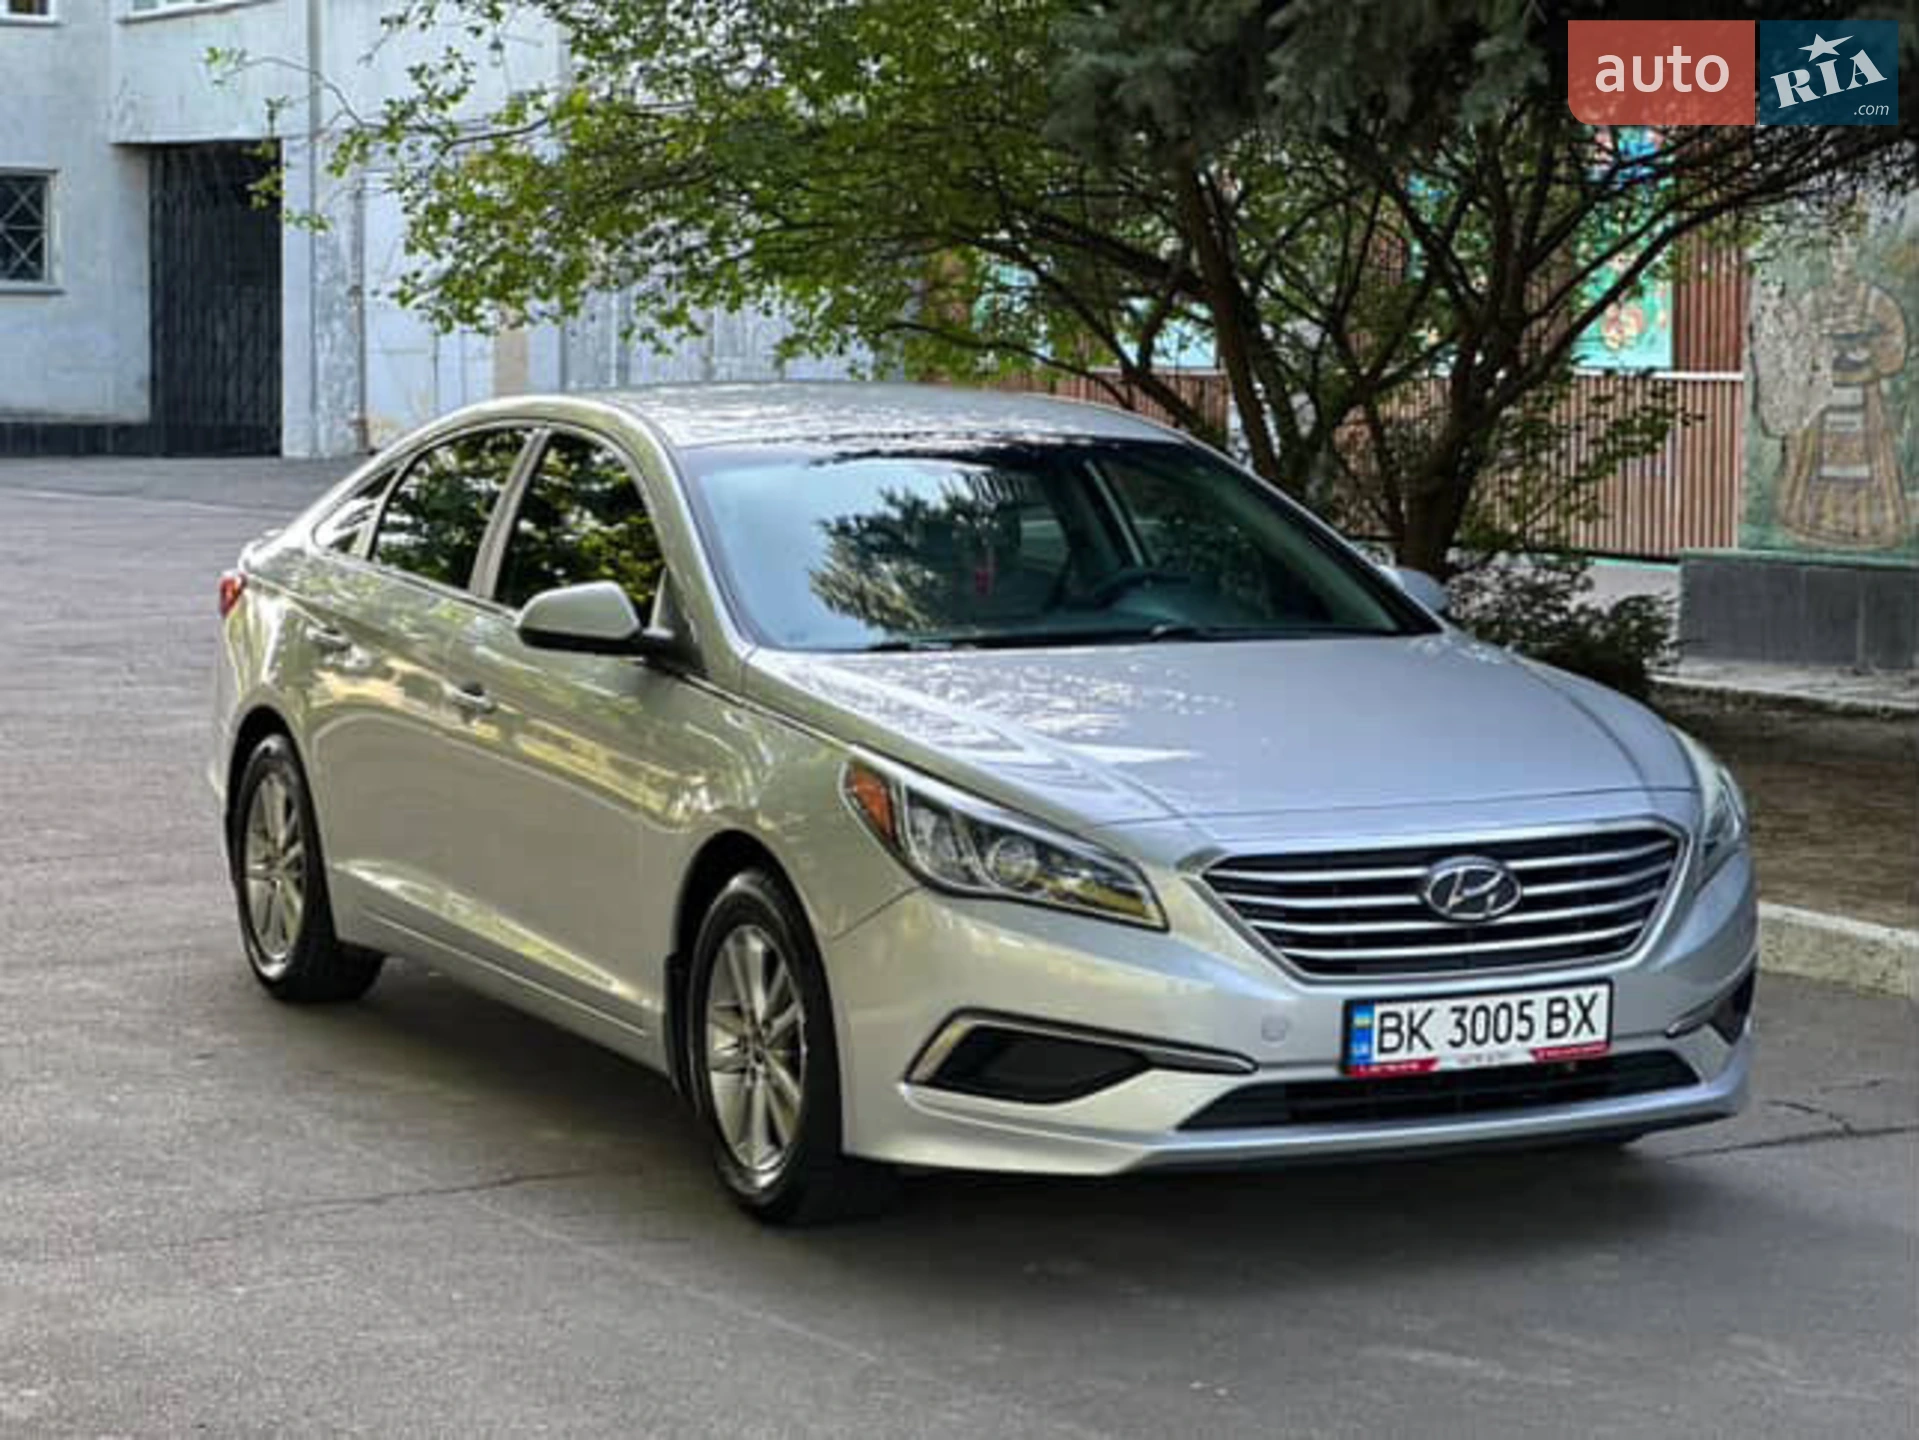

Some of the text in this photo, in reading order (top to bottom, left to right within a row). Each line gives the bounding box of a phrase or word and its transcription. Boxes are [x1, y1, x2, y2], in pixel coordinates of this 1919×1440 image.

[1377, 992, 1599, 1054] BK 3005 BX
